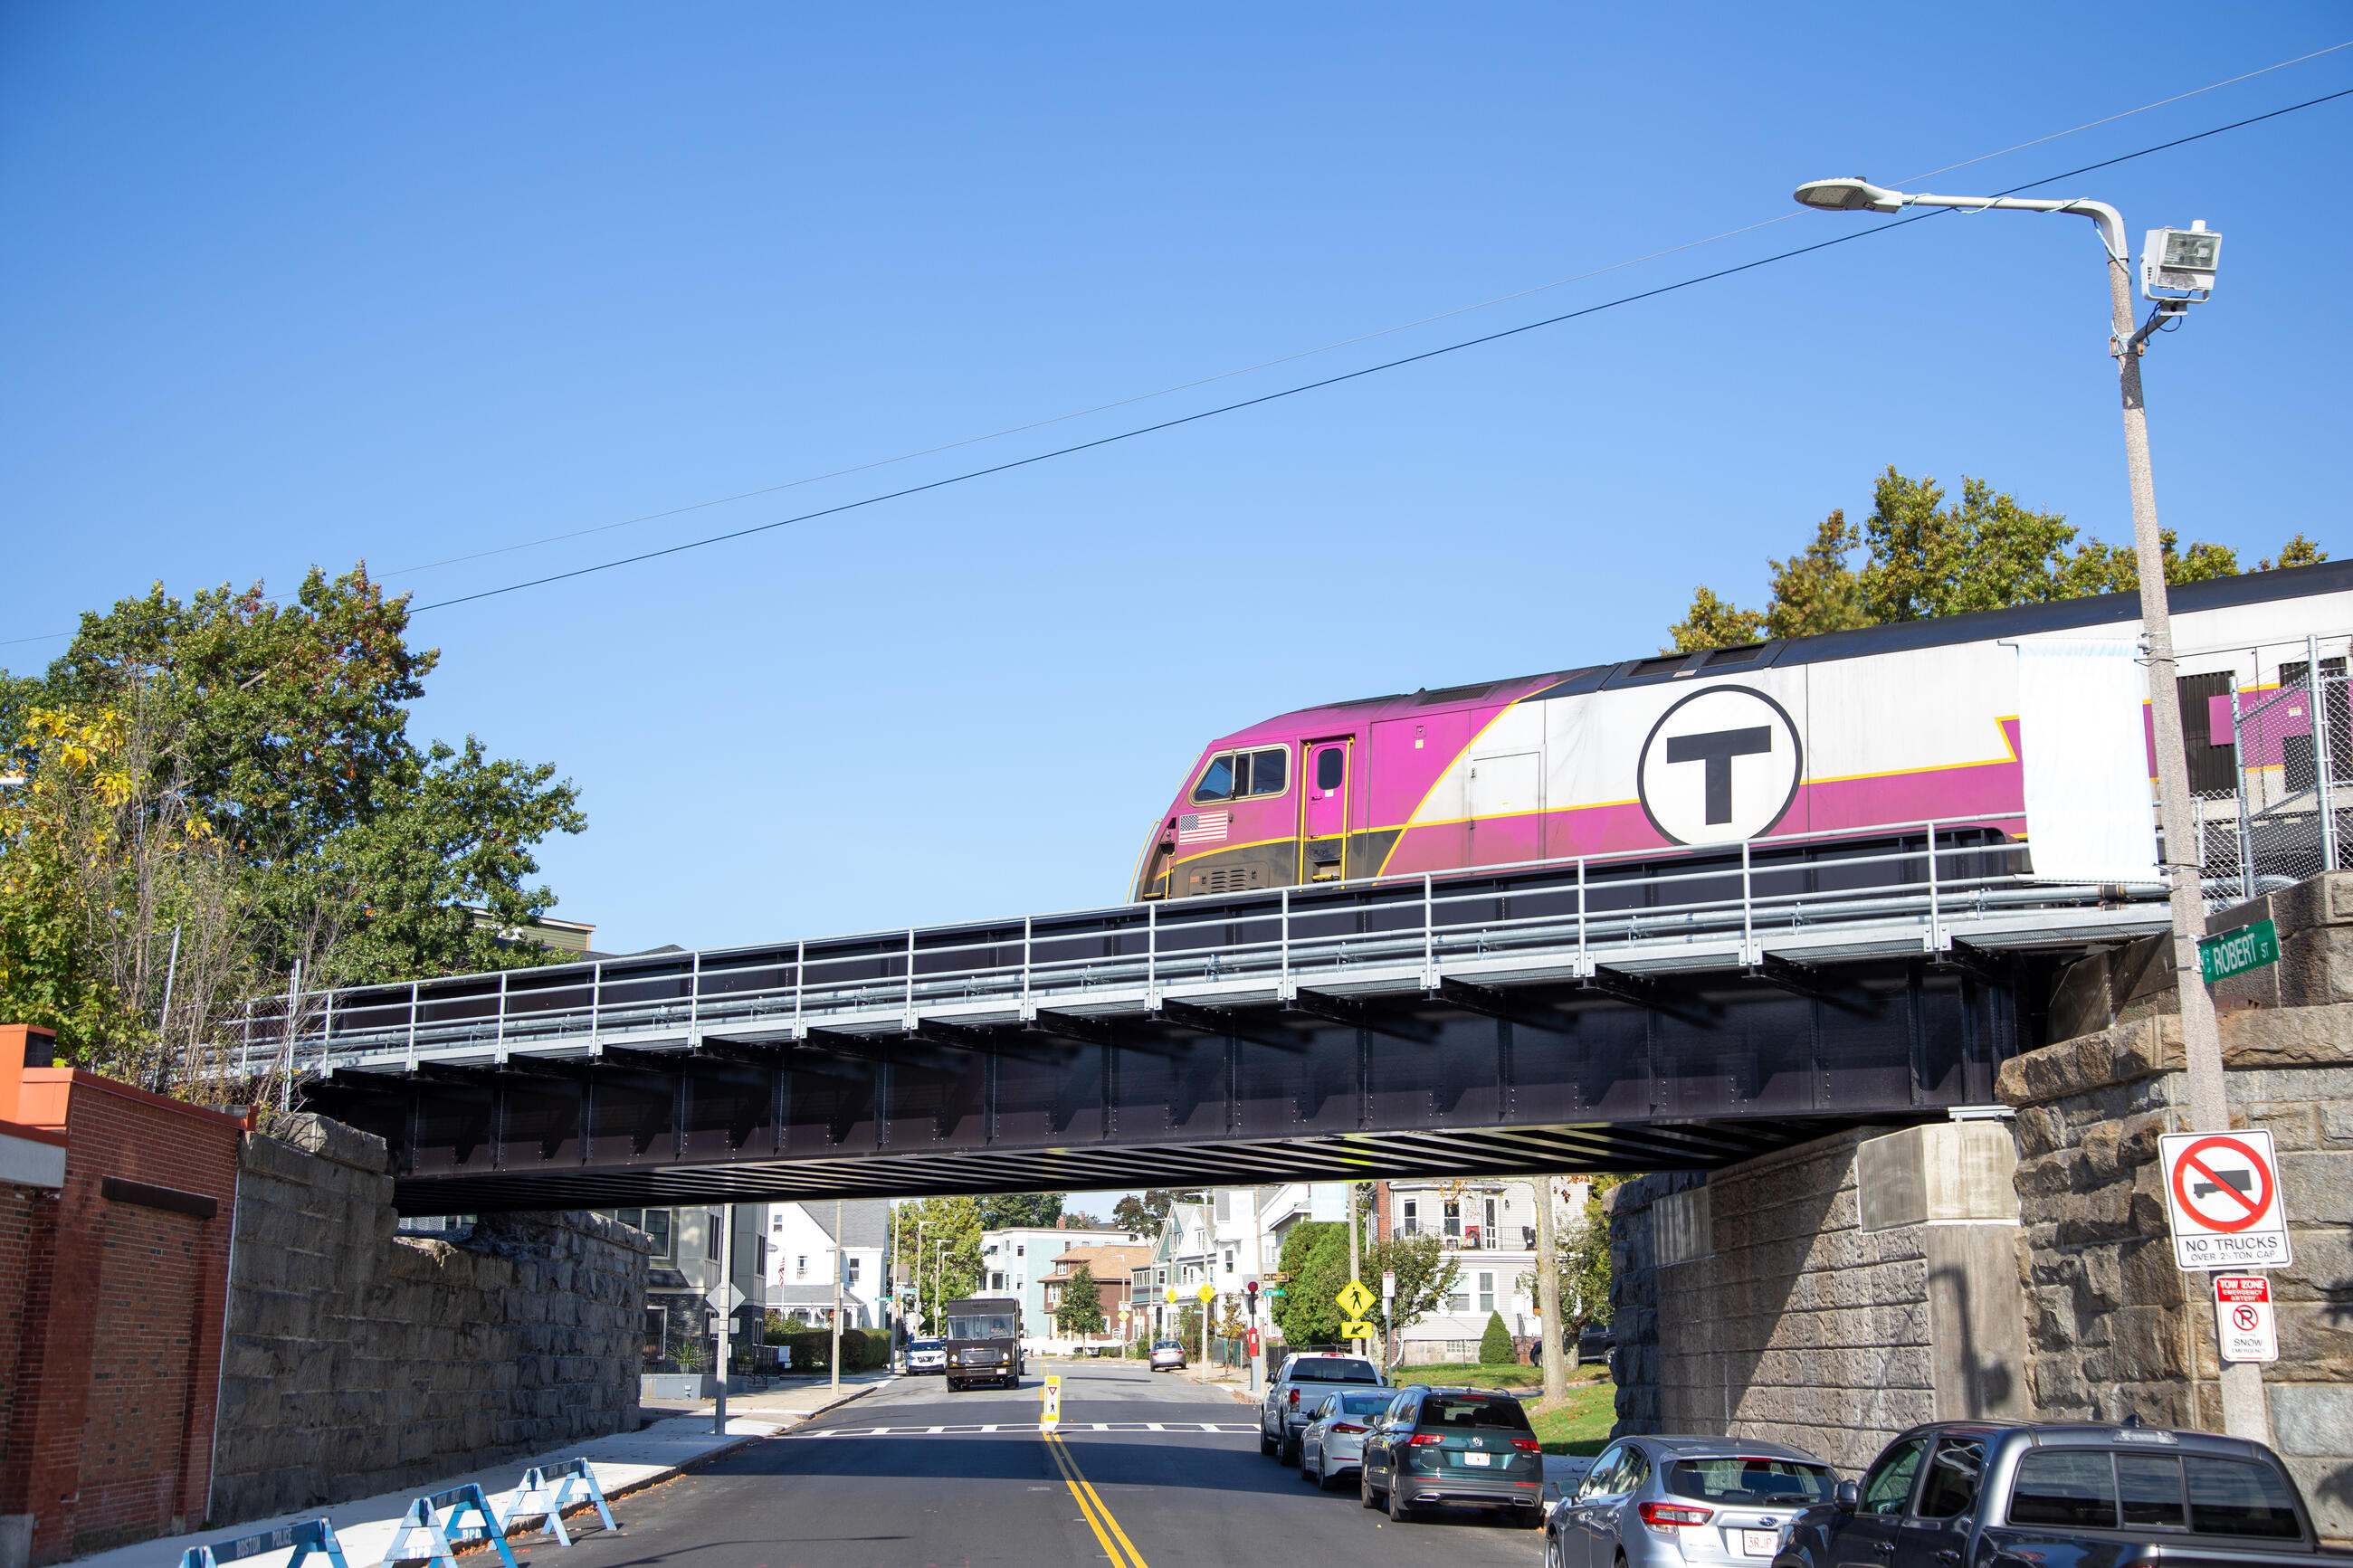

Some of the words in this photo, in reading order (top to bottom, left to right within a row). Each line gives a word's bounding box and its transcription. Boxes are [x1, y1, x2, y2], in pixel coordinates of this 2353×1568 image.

[1666, 726, 1771, 825] T
[2213, 933, 2257, 975] ROBERT
[2261, 941, 2270, 959] ST
[2185, 1239, 2208, 1252] NO
[2214, 1236, 2278, 1250] TRUCKS
[2190, 1252, 2216, 1262] OVER
[2233, 1251, 2253, 1259] TON
[2218, 1279, 2239, 1289] TOW
[2241, 1279, 2265, 1289] ZONE
[2233, 1337, 2263, 1347] SNOW
[462, 1527, 481, 1539] BPD
[235, 1535, 262, 1558] BOSTON
[272, 1527, 292, 1548] POLICE
[408, 1546, 432, 1560] BPD
